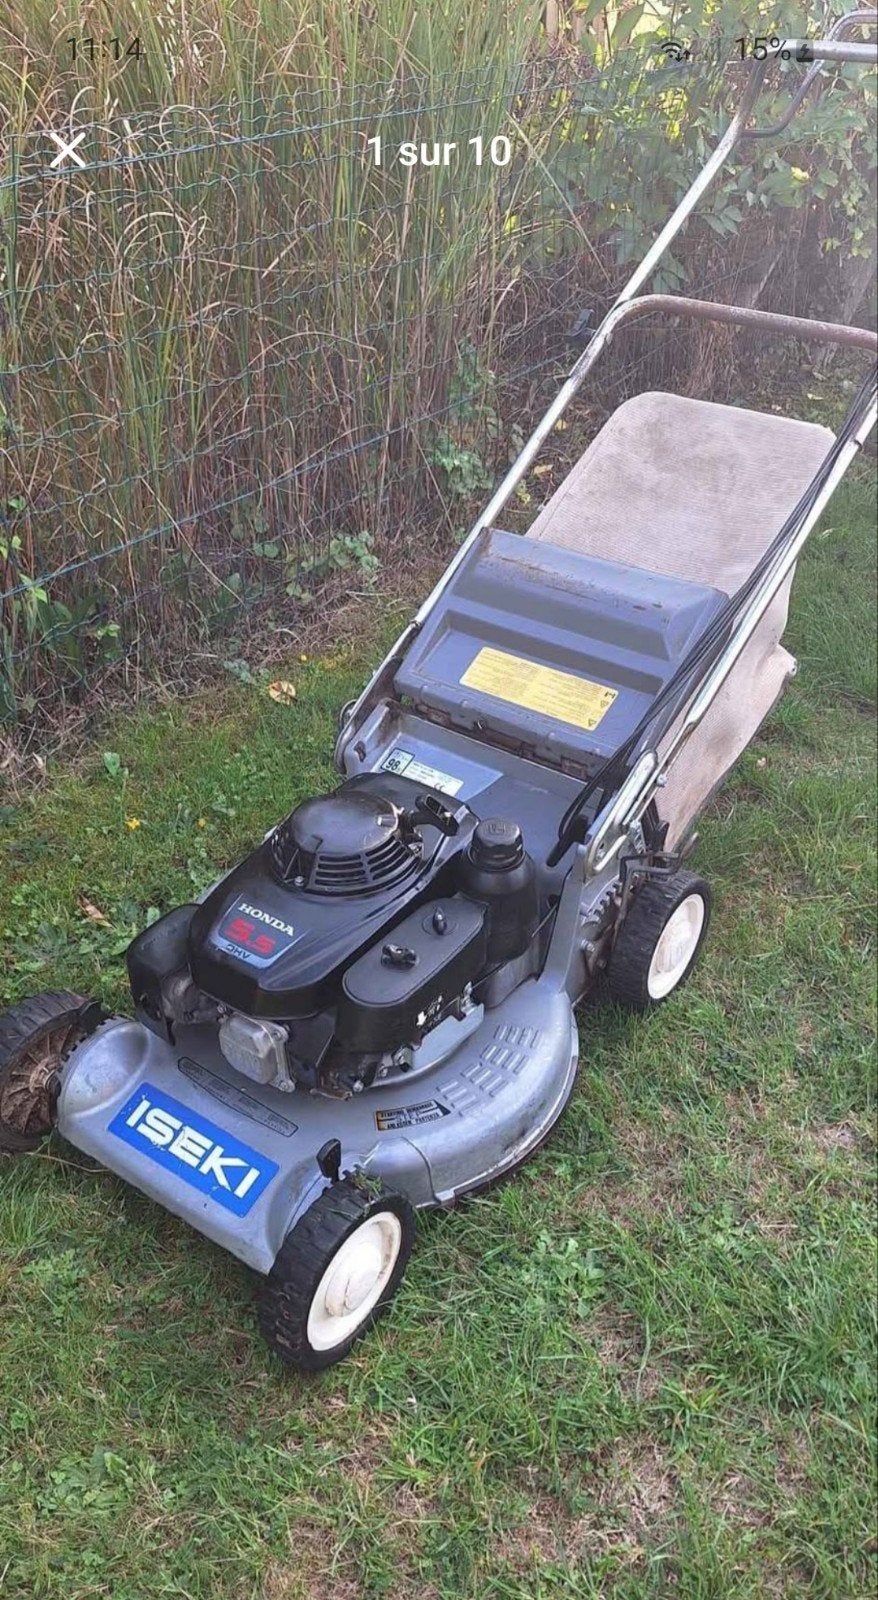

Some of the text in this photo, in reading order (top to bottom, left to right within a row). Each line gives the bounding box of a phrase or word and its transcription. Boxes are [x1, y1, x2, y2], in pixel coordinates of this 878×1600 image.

[385, 758, 401, 771] 98
[224, 917, 276, 955] 5.5
[238, 903, 295, 936] HONDA
[125, 1099, 261, 1199] ISEKI
